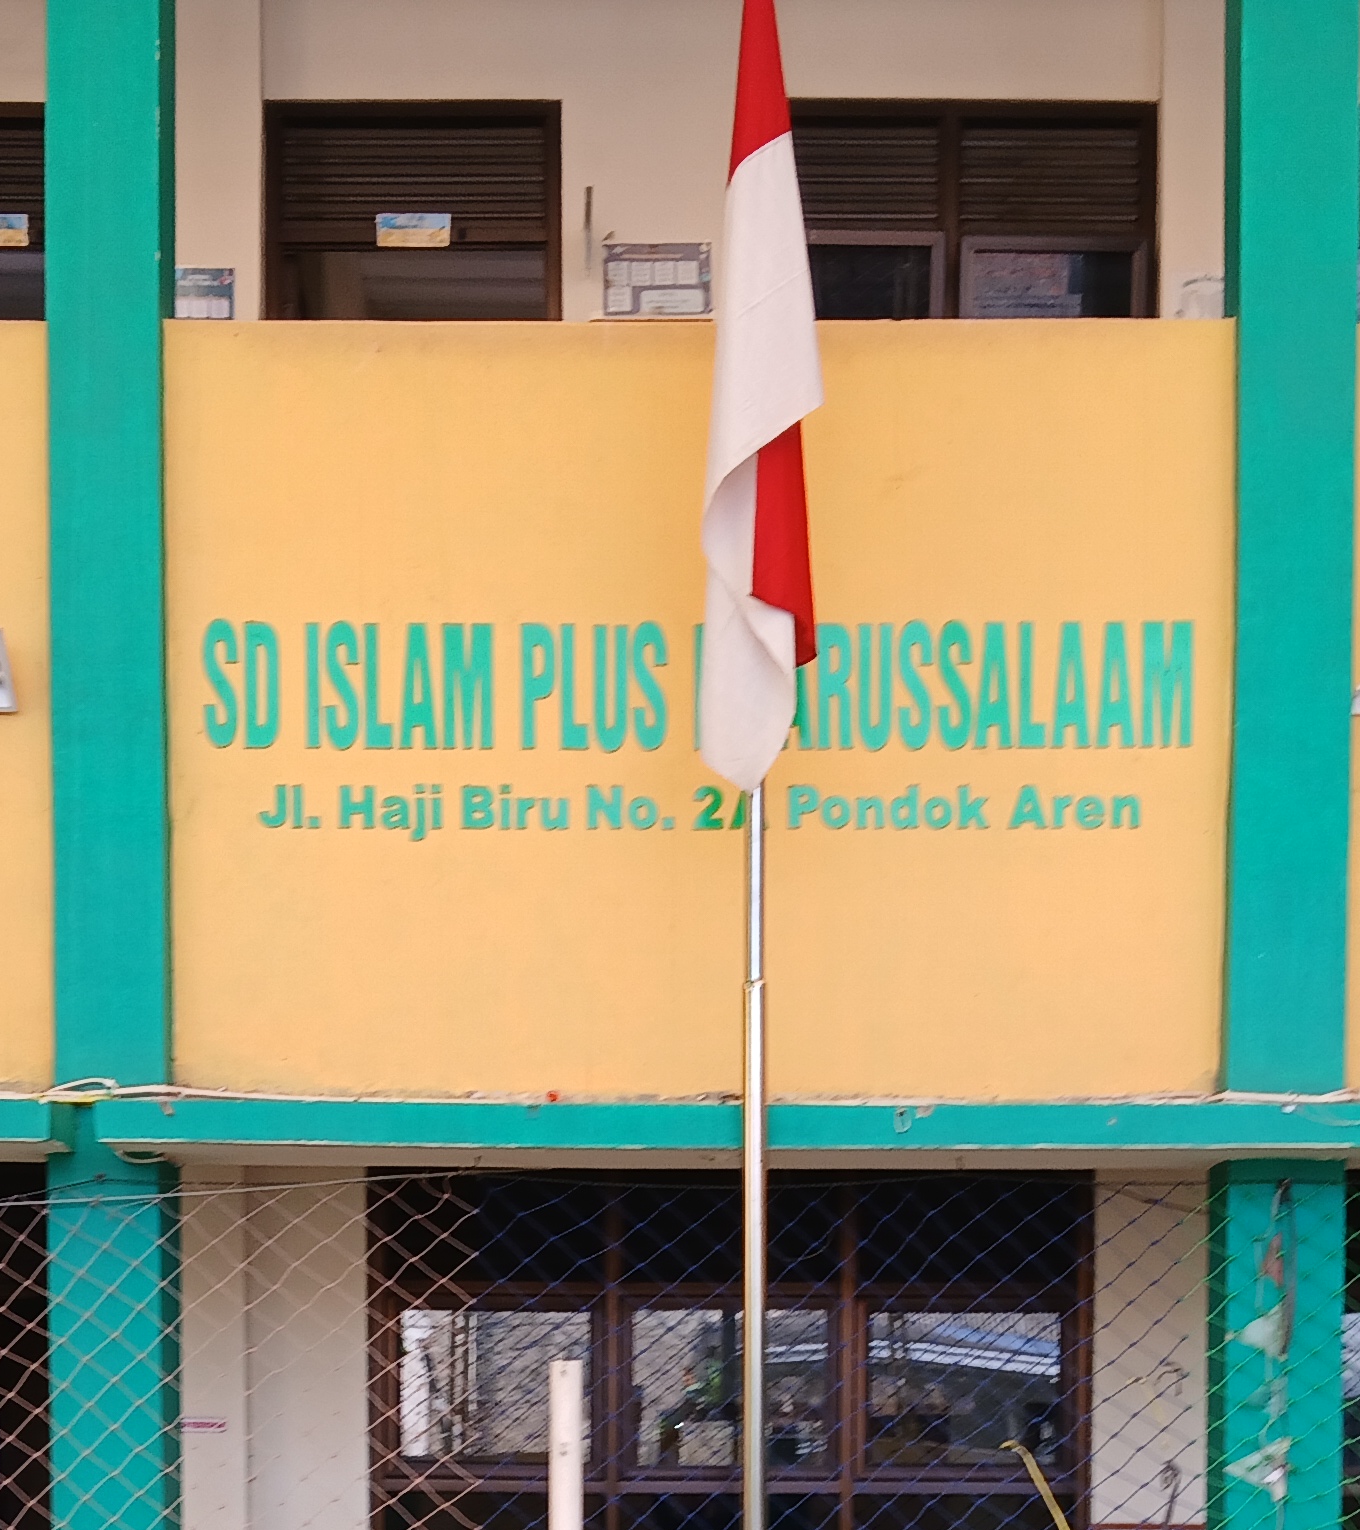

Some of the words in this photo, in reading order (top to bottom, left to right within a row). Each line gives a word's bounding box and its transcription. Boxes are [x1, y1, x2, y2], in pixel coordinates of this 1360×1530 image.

[201, 618, 282, 751] SD
[304, 618, 496, 751] ISLAM
[519, 619, 670, 752] PLUS
[693, 618, 1197, 752] RUSSALAAM
[257, 783, 321, 831] Jl.
[337, 783, 444, 842] Haji
[459, 784, 570, 832] Biru
[585, 784, 675, 832] No.
[786, 783, 989, 831] Pondok
[1007, 783, 1143, 831] Aren
